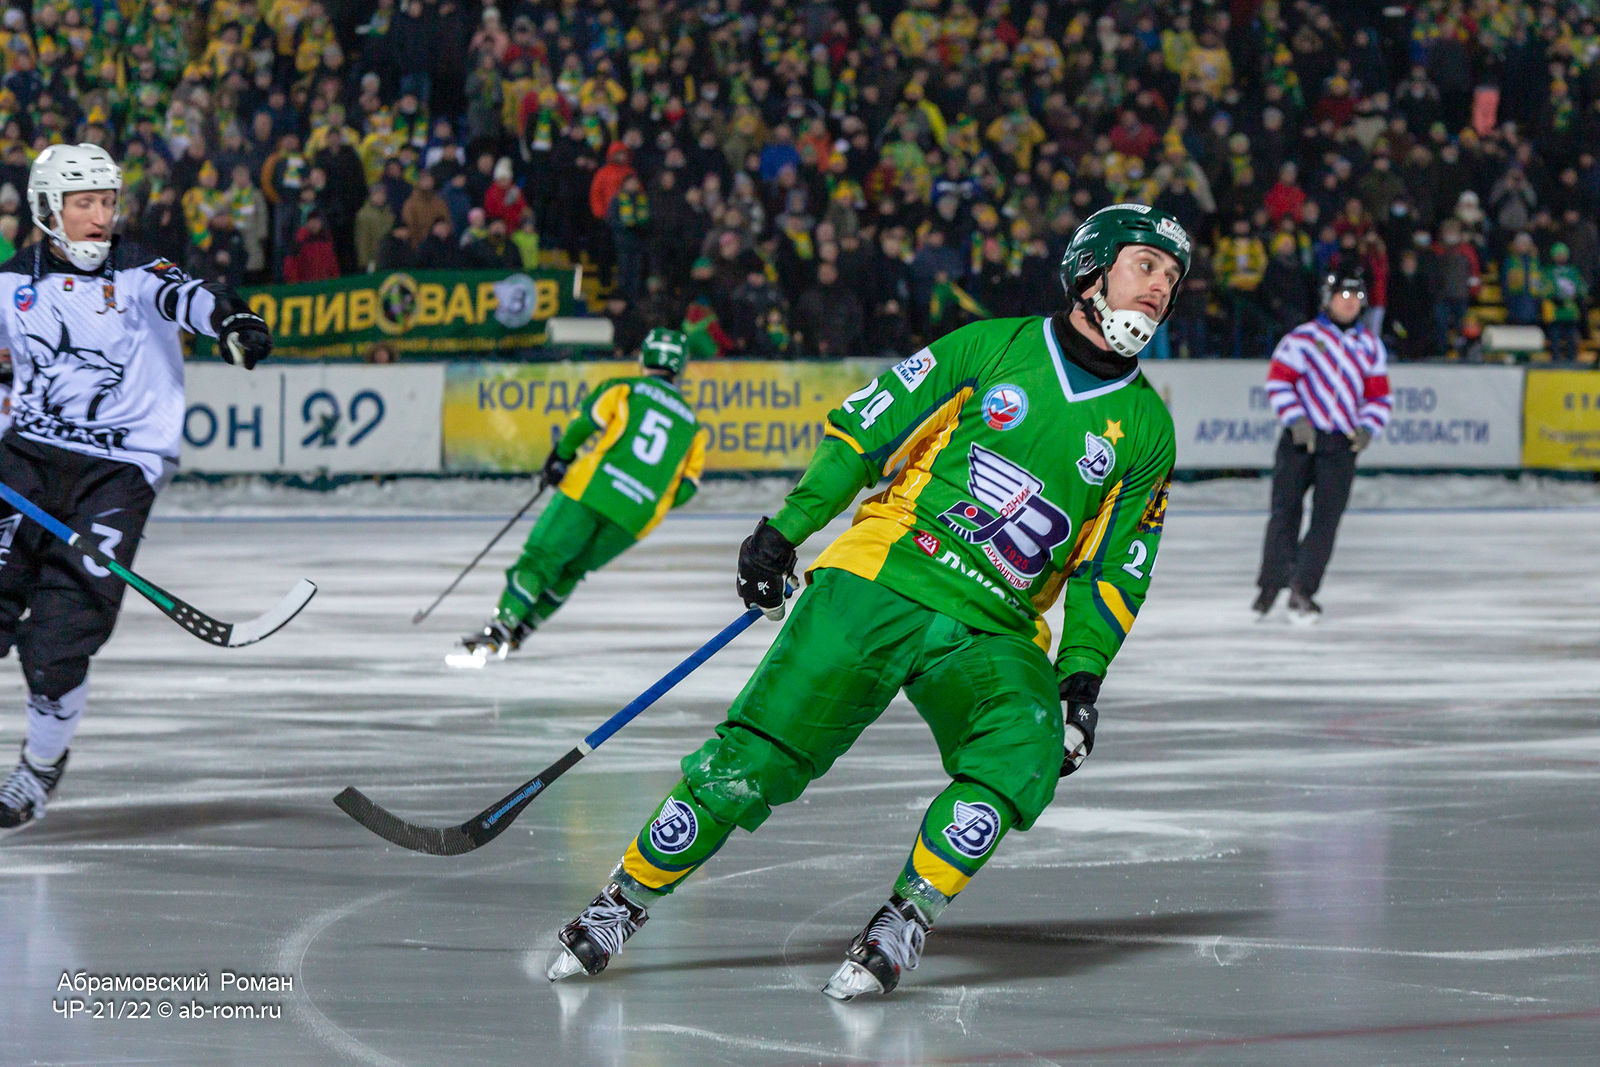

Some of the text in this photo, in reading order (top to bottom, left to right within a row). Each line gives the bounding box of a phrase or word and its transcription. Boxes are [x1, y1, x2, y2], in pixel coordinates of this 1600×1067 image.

[301, 389, 386, 448] 29
[478, 380, 590, 415] КОГДА
[842, 377, 895, 431] 24
[632, 408, 673, 466] 5
[1387, 420, 1489, 445] ОБЛАСТИ
[82, 522, 123, 578] 3
[1122, 539, 1159, 579] 2
